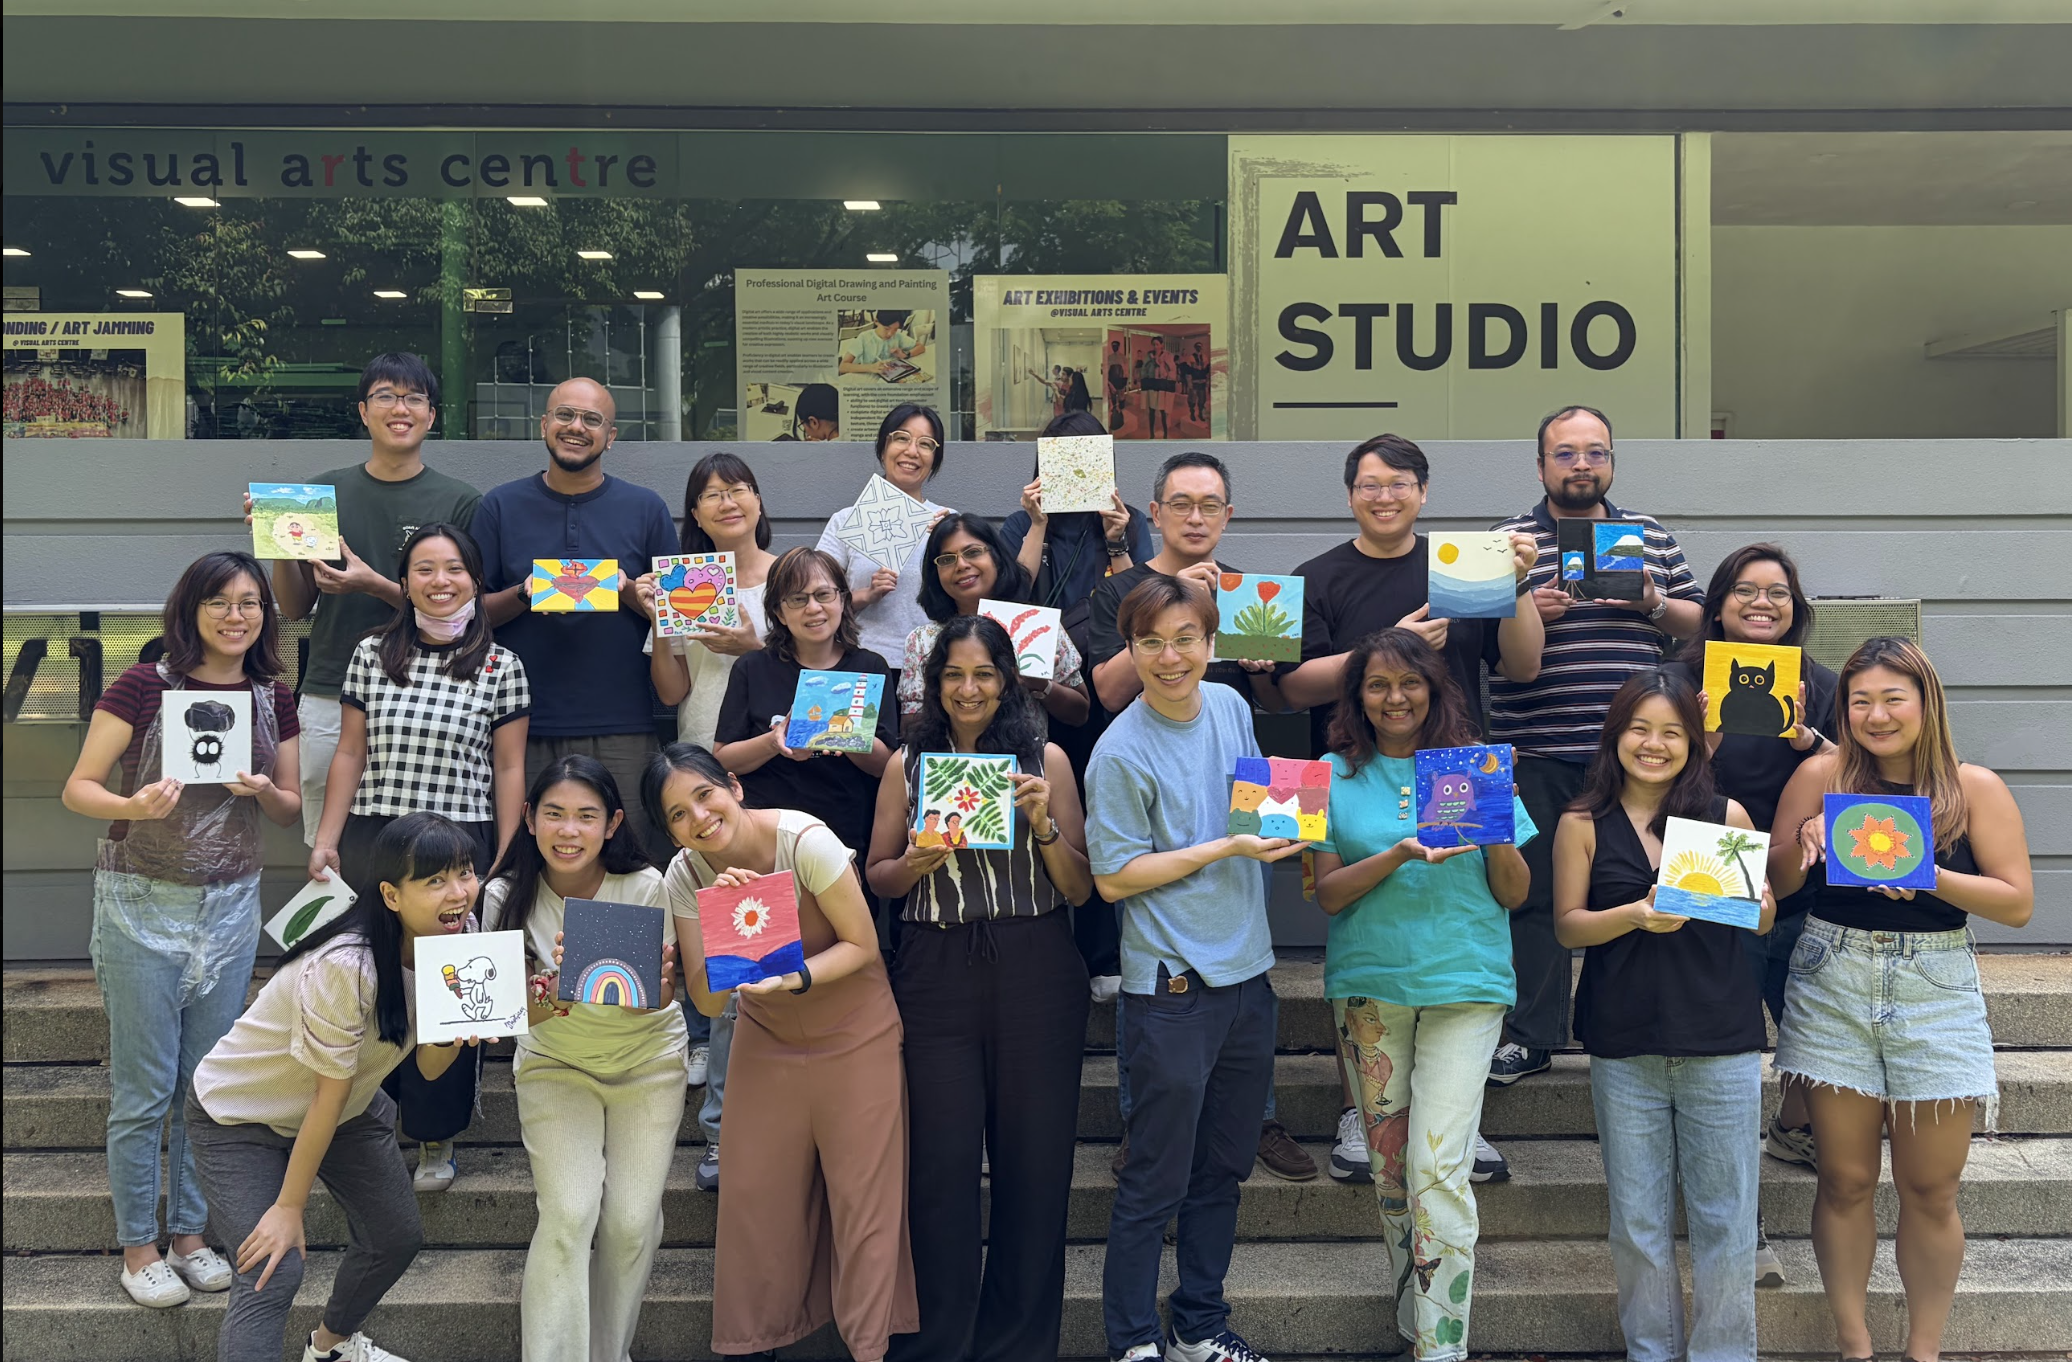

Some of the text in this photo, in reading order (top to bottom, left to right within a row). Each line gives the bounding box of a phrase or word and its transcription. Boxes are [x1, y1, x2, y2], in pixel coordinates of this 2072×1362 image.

[40, 142, 658, 188] visual arts centre
[1273, 191, 1458, 259] ART
[746, 279, 937, 290] Professional Digital Drawing and Painting
[816, 293, 867, 302] Art Course
[1003, 289, 1199, 306] ART EXHIBITIONS & EVENTS
[1050, 308, 1147, 318] @VISUAL ARTS CENTRE
[50, 322, 59, 335] /
[62, 321, 91, 335] ART
[93, 321, 155, 335] JAMMING
[1273, 300, 1638, 372] STUDIO
